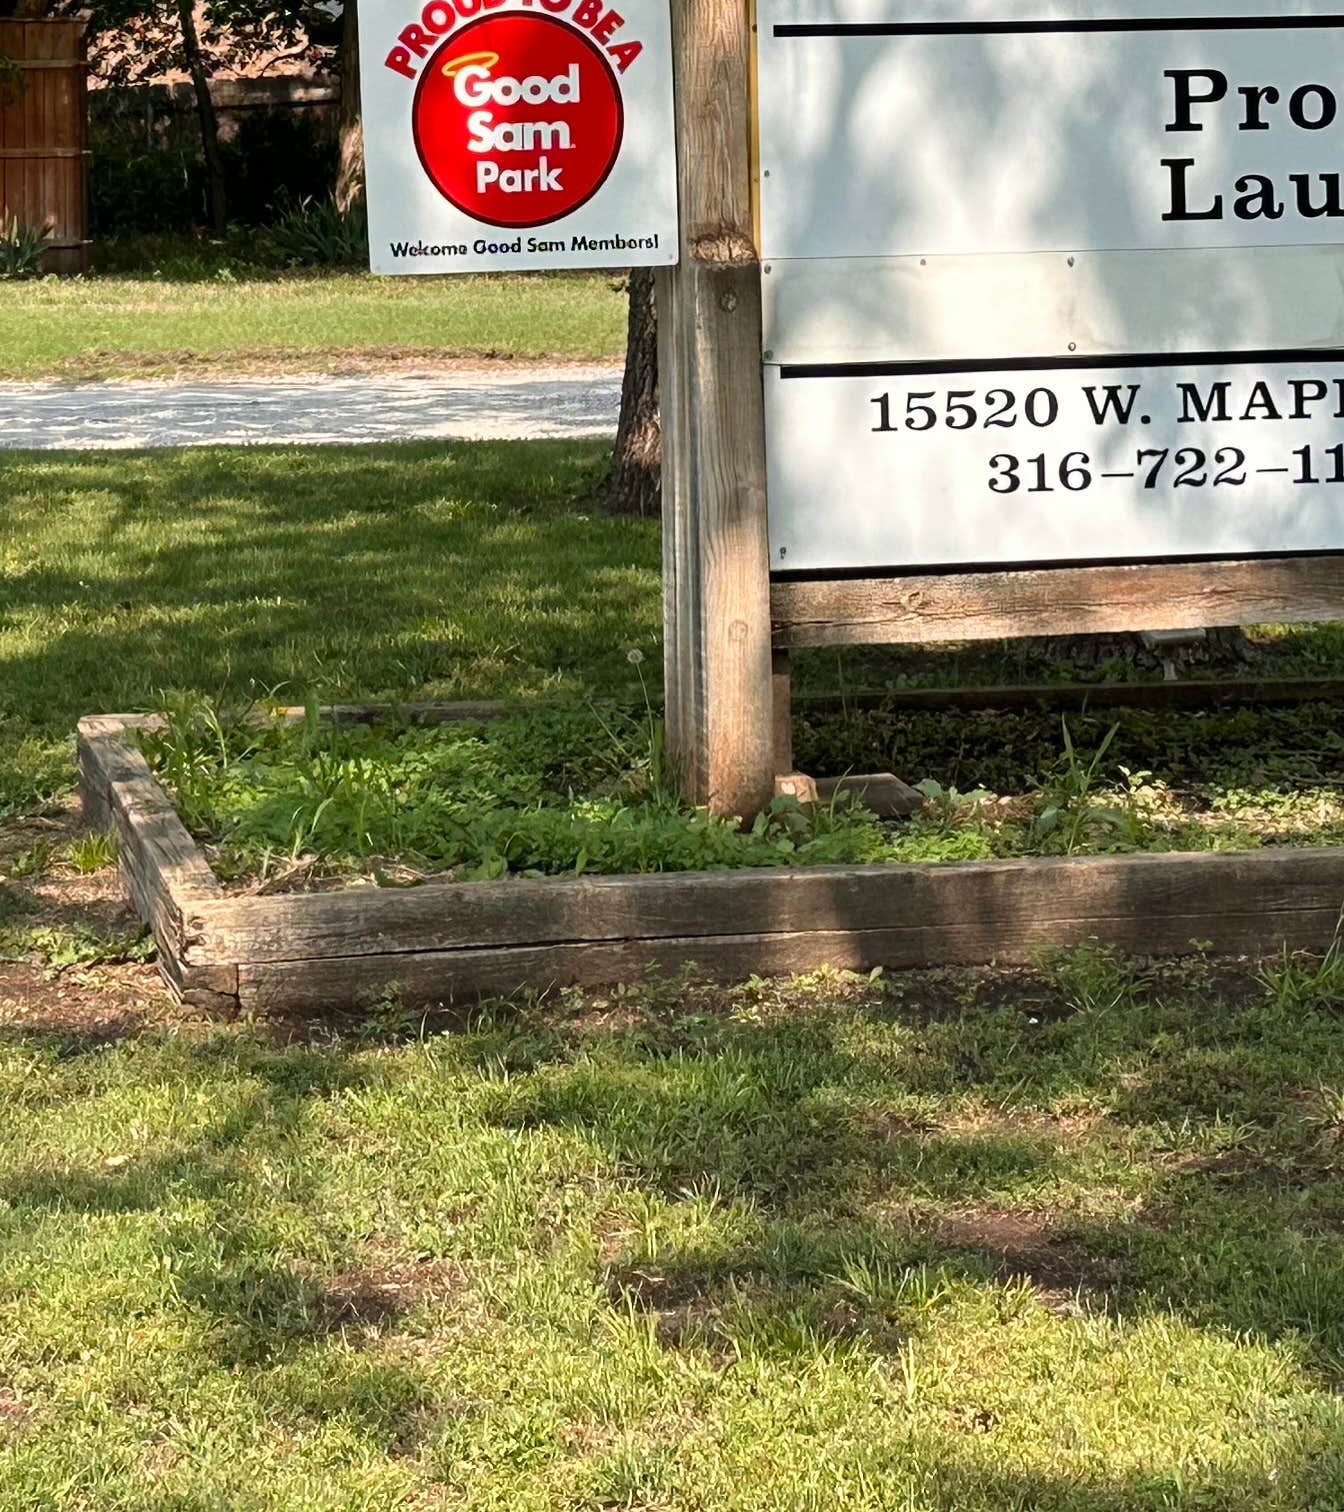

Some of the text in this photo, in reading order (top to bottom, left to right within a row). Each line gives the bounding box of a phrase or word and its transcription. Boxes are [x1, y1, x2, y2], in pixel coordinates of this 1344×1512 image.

[606, 40, 643, 74] A
[453, 63, 580, 107] Good
[467, 111, 570, 153] Sam
[476, 156, 563, 193] Park
[390, 241, 468, 257] Welcome
[473, 237, 521, 255] Good
[527, 237, 565, 253] Sam
[871, 388, 1058, 431] 15520
[1082, 385, 1150, 425] W.
